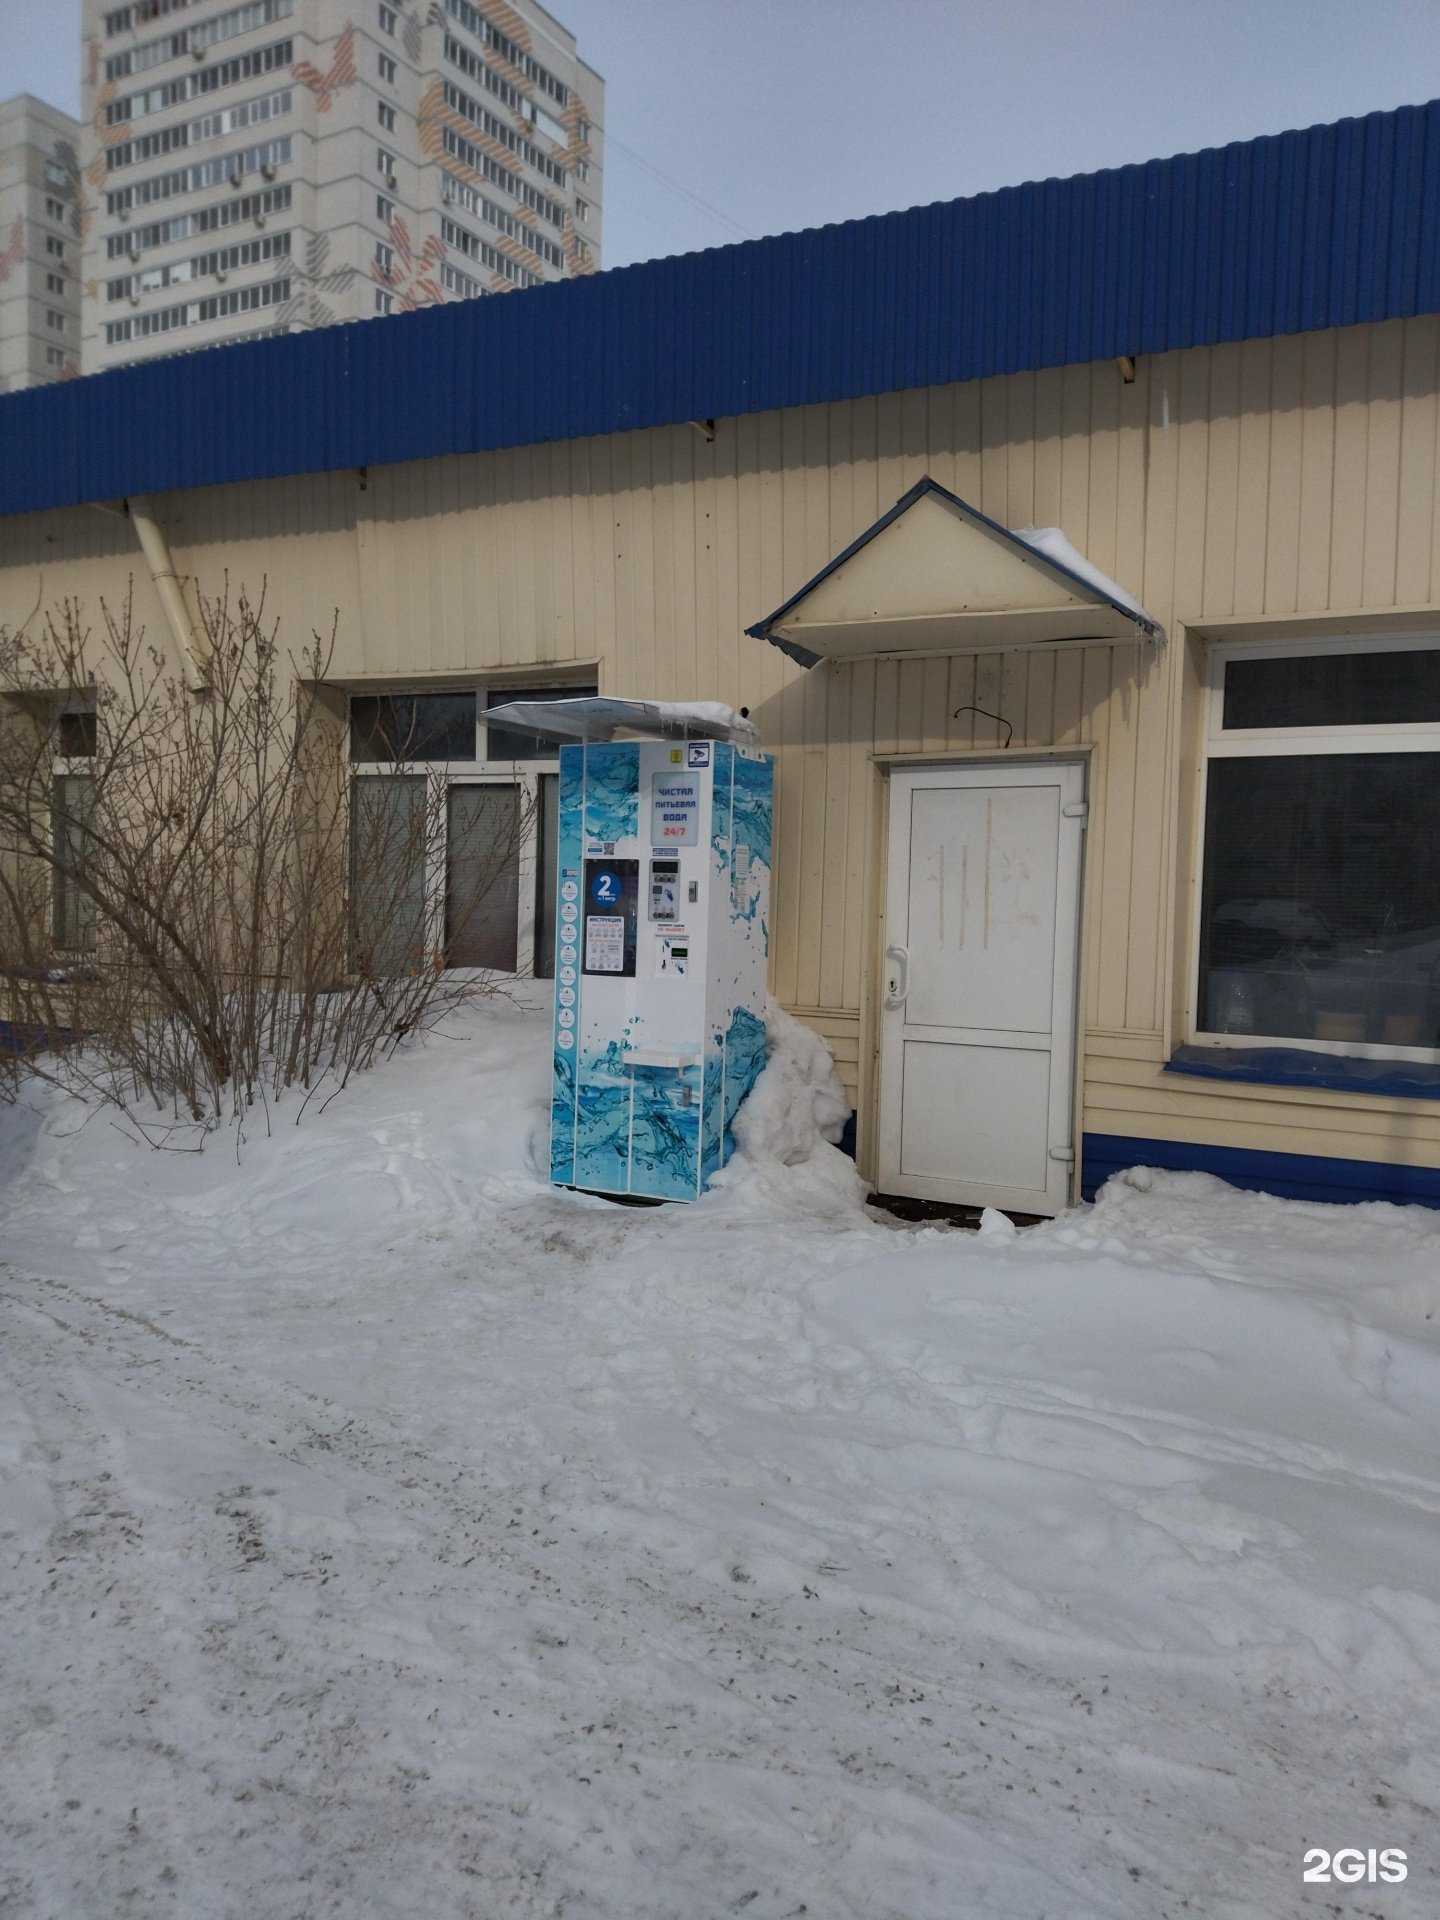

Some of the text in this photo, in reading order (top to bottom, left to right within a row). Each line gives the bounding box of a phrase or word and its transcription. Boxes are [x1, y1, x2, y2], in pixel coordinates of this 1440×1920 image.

[658, 787, 694, 797] ЧИСТАЯ
[655, 800, 697, 809] ПИТЬЕВАЯ
[663, 813, 688, 822] ВОДА
[663, 827, 686, 837] 24/7
[597, 875, 612, 897] 2
